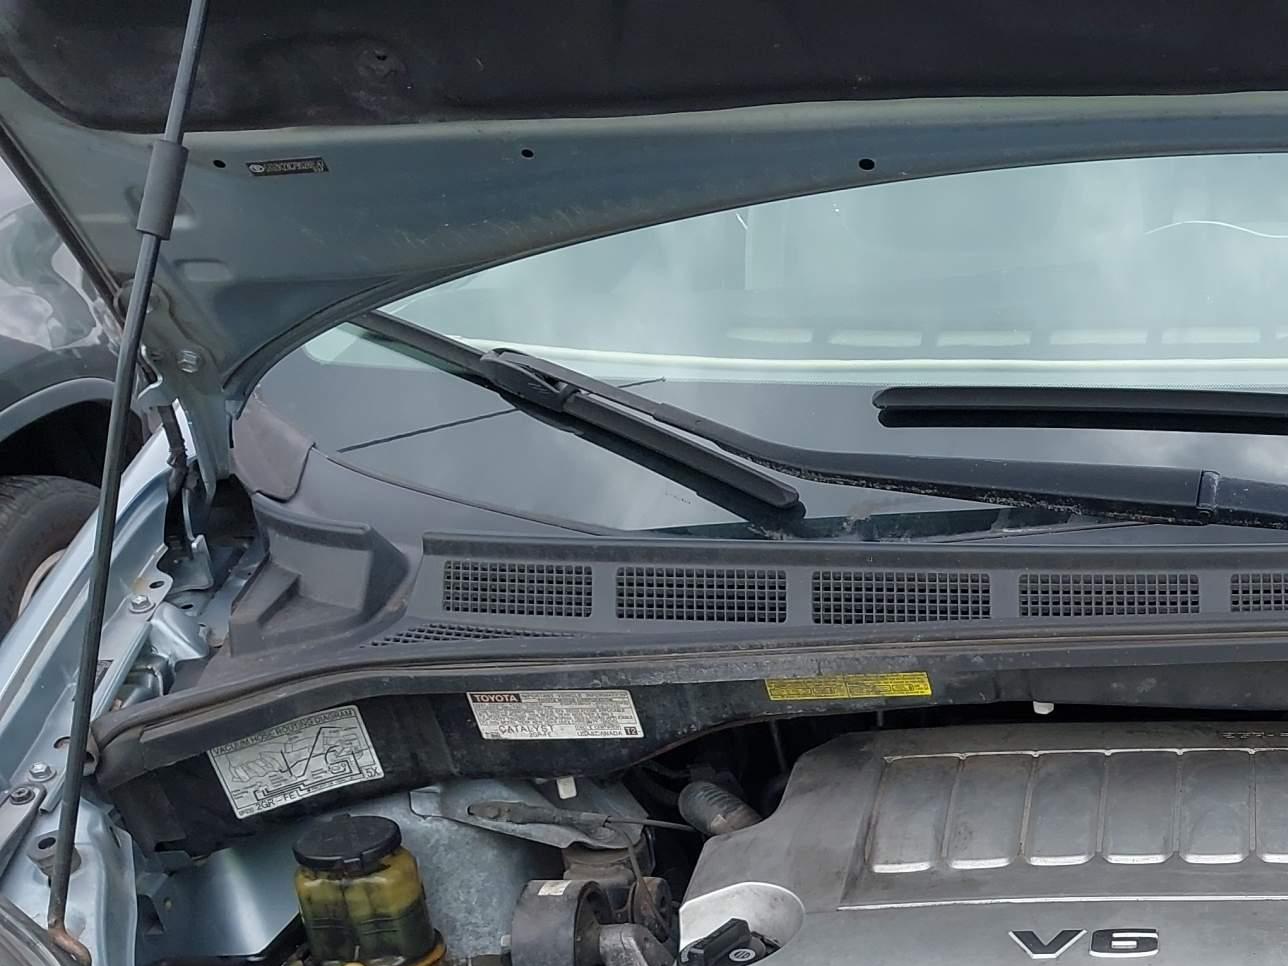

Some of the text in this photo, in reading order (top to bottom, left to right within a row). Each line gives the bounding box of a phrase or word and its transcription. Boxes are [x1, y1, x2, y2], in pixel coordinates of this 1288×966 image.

[474, 694, 518, 703] TOYOTA
[498, 725, 554, 734] CATALYST
[366, 767, 380, 779] 5X
[1008, 928, 1159, 959] V6
